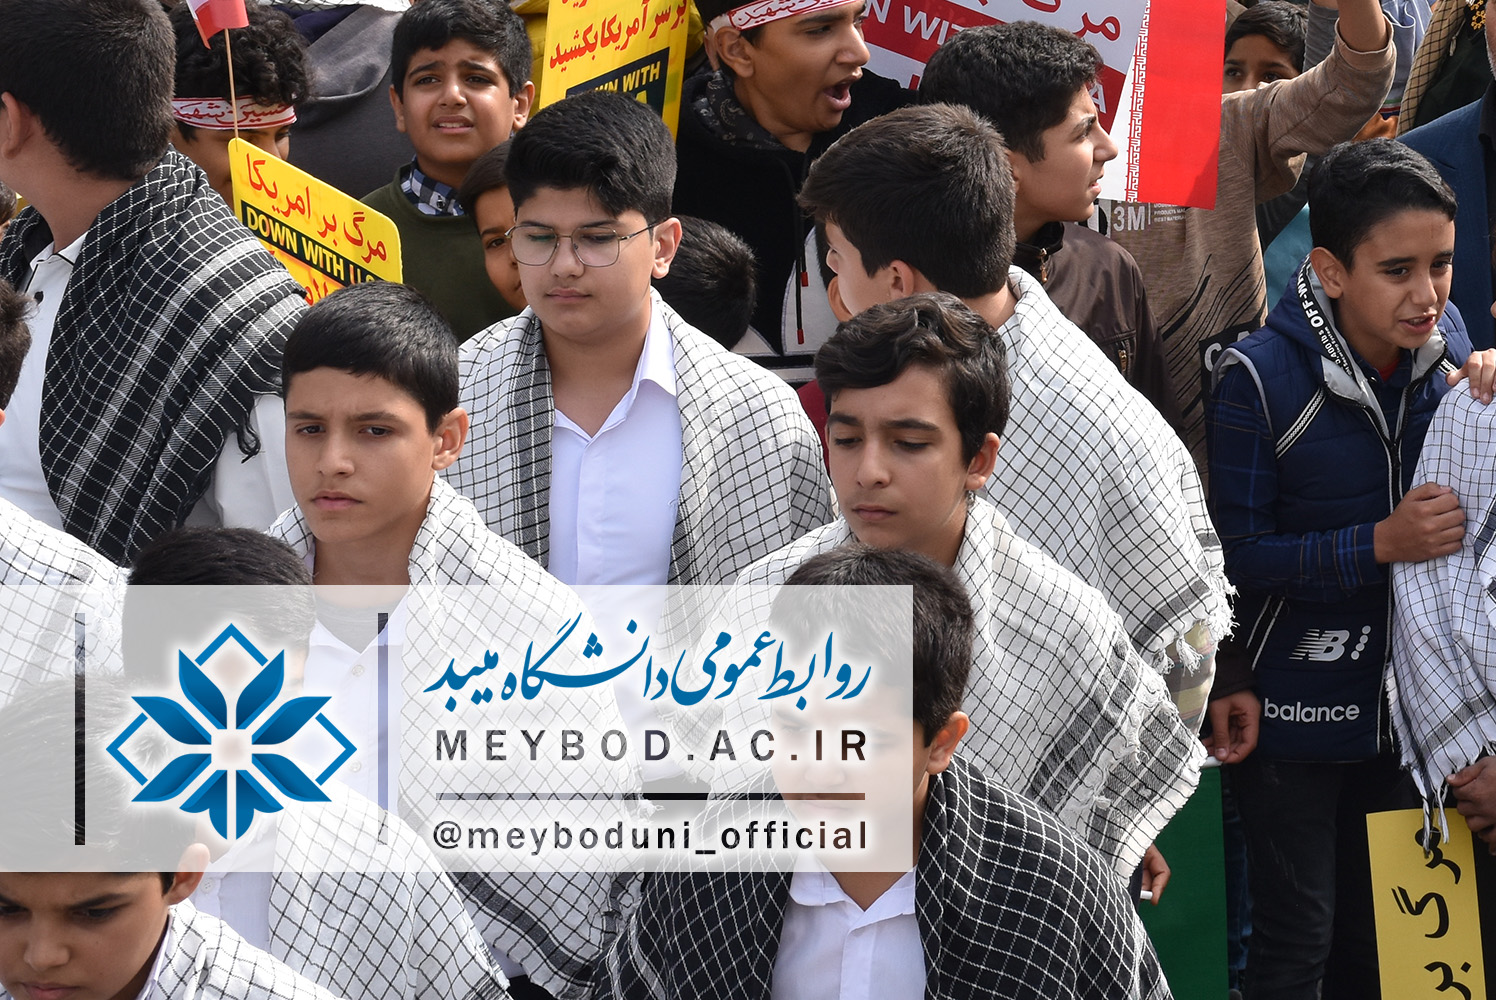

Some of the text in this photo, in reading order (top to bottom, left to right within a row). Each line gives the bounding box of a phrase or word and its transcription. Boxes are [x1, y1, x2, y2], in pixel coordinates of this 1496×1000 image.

[549, 7, 671, 73] سر بکشید
[246, 153, 387, 264] مرگ بر امریکا
[1113, 206, 1145, 231] 3M
[1264, 699, 1360, 724] balance
[1392, 826, 1462, 938] مرگ
